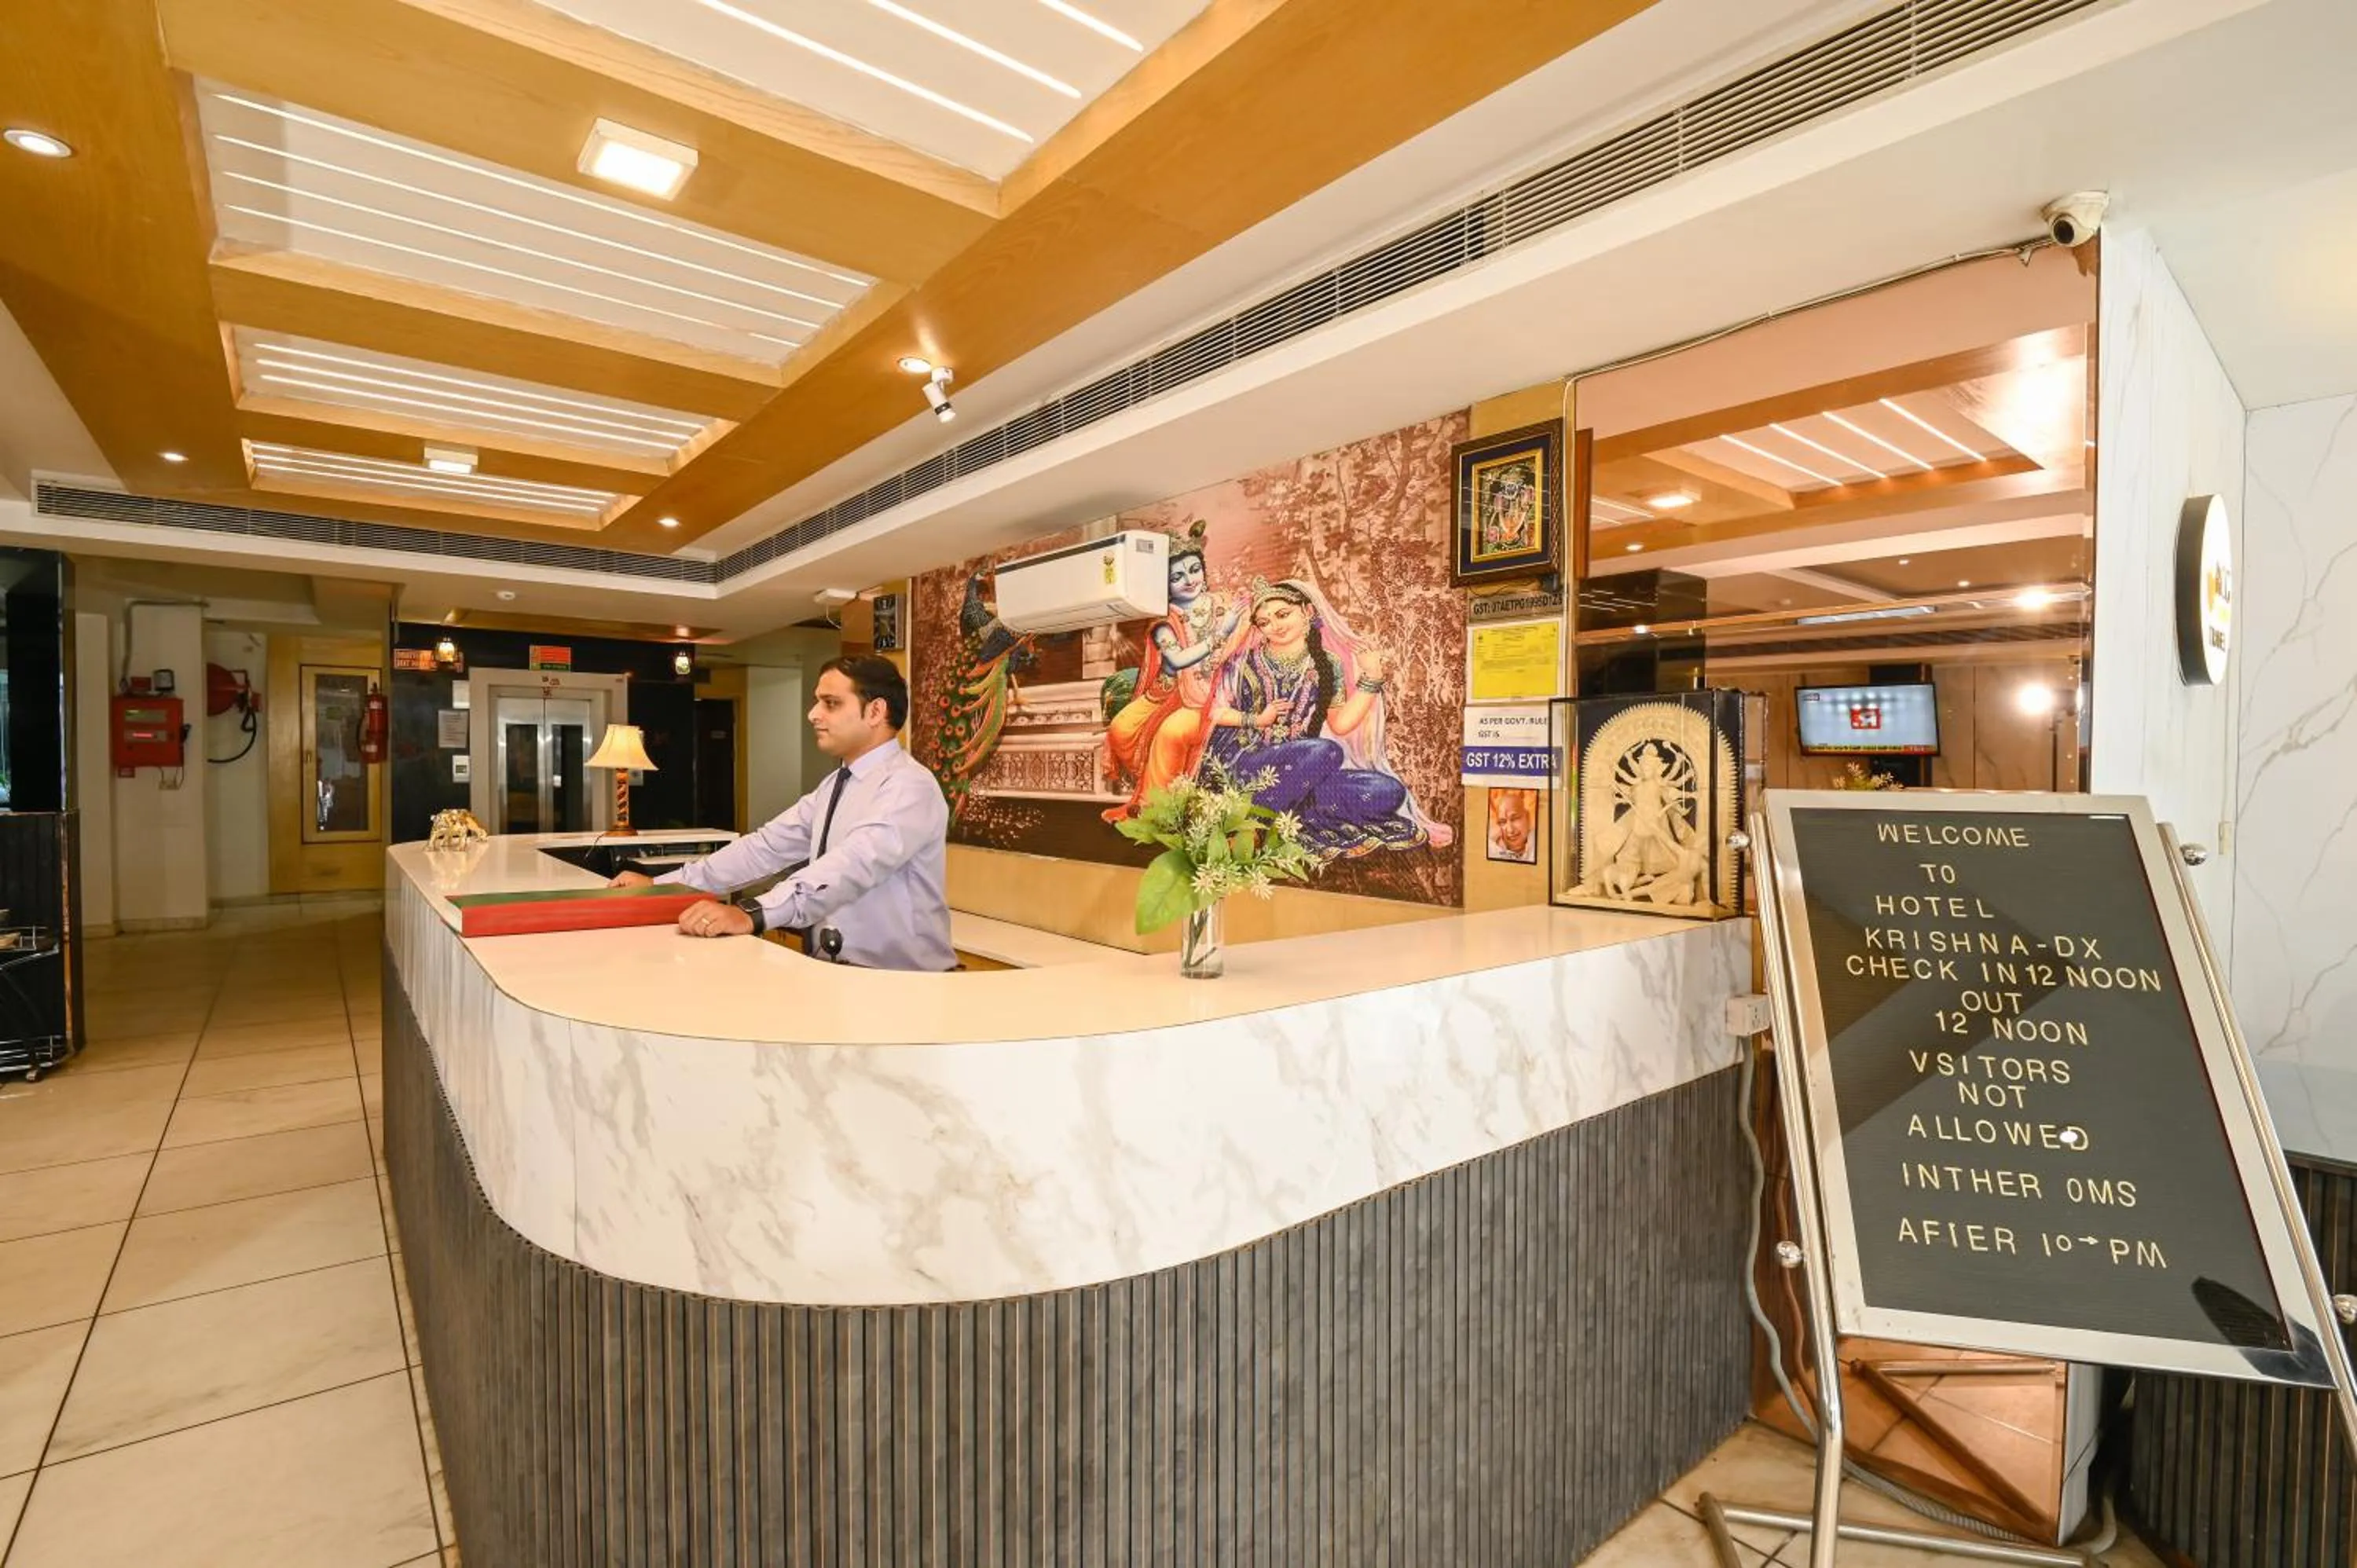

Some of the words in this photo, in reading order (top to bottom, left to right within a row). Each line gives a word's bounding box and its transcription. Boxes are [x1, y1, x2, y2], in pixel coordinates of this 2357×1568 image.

[1466, 752, 1490, 768] GST
[1492, 753, 1516, 769] 12%
[1877, 823, 2029, 847] WELCOME
[1919, 863, 1956, 884] TO
[1875, 895, 1994, 918] HOTEL
[1847, 954, 1959, 981] CHECK
[1981, 962, 2017, 984] IN
[2025, 964, 2056, 986] 12
[2066, 965, 2161, 992] NOON
[1961, 991, 2022, 1014] OUT
[1935, 1010, 1968, 1034] 12
[1992, 1017, 2088, 1046] NOON
[1909, 1050, 2070, 1084] VSITORS
[1958, 1081, 2026, 1109] NOT
[1908, 1114, 2089, 1151] ALLOWED
[1902, 1162, 2042, 1199] INTHER
